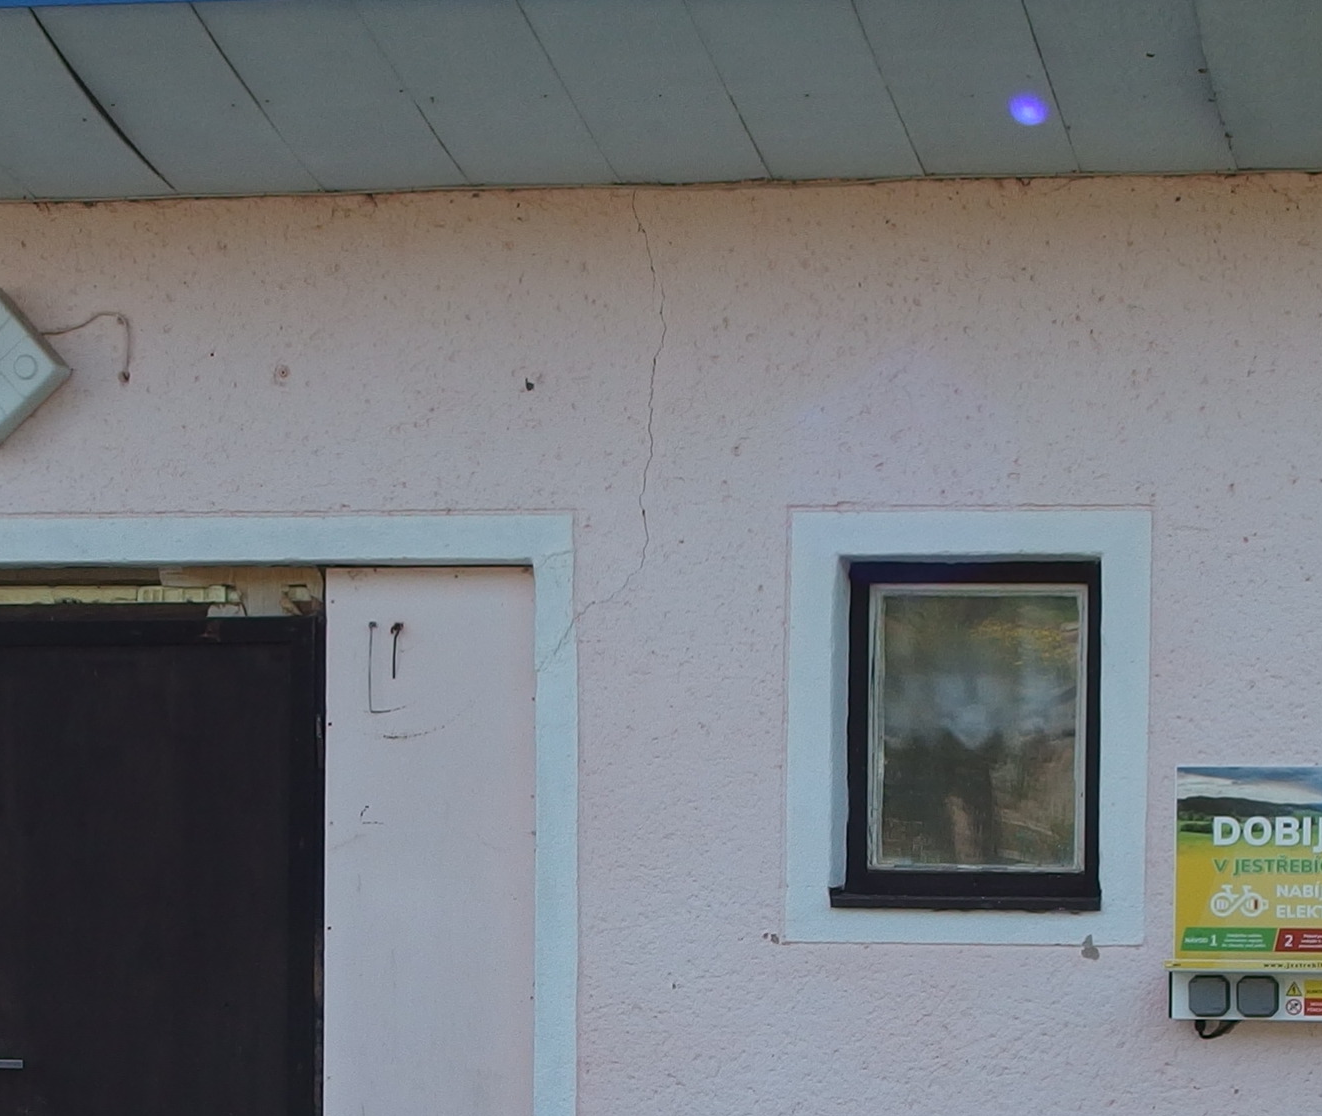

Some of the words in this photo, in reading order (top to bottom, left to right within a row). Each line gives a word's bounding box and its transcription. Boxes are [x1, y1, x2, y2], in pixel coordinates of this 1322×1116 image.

[1213, 859, 1228, 873] V
[1209, 934, 1217, 947] 1
[1284, 934, 1293, 947] 2
